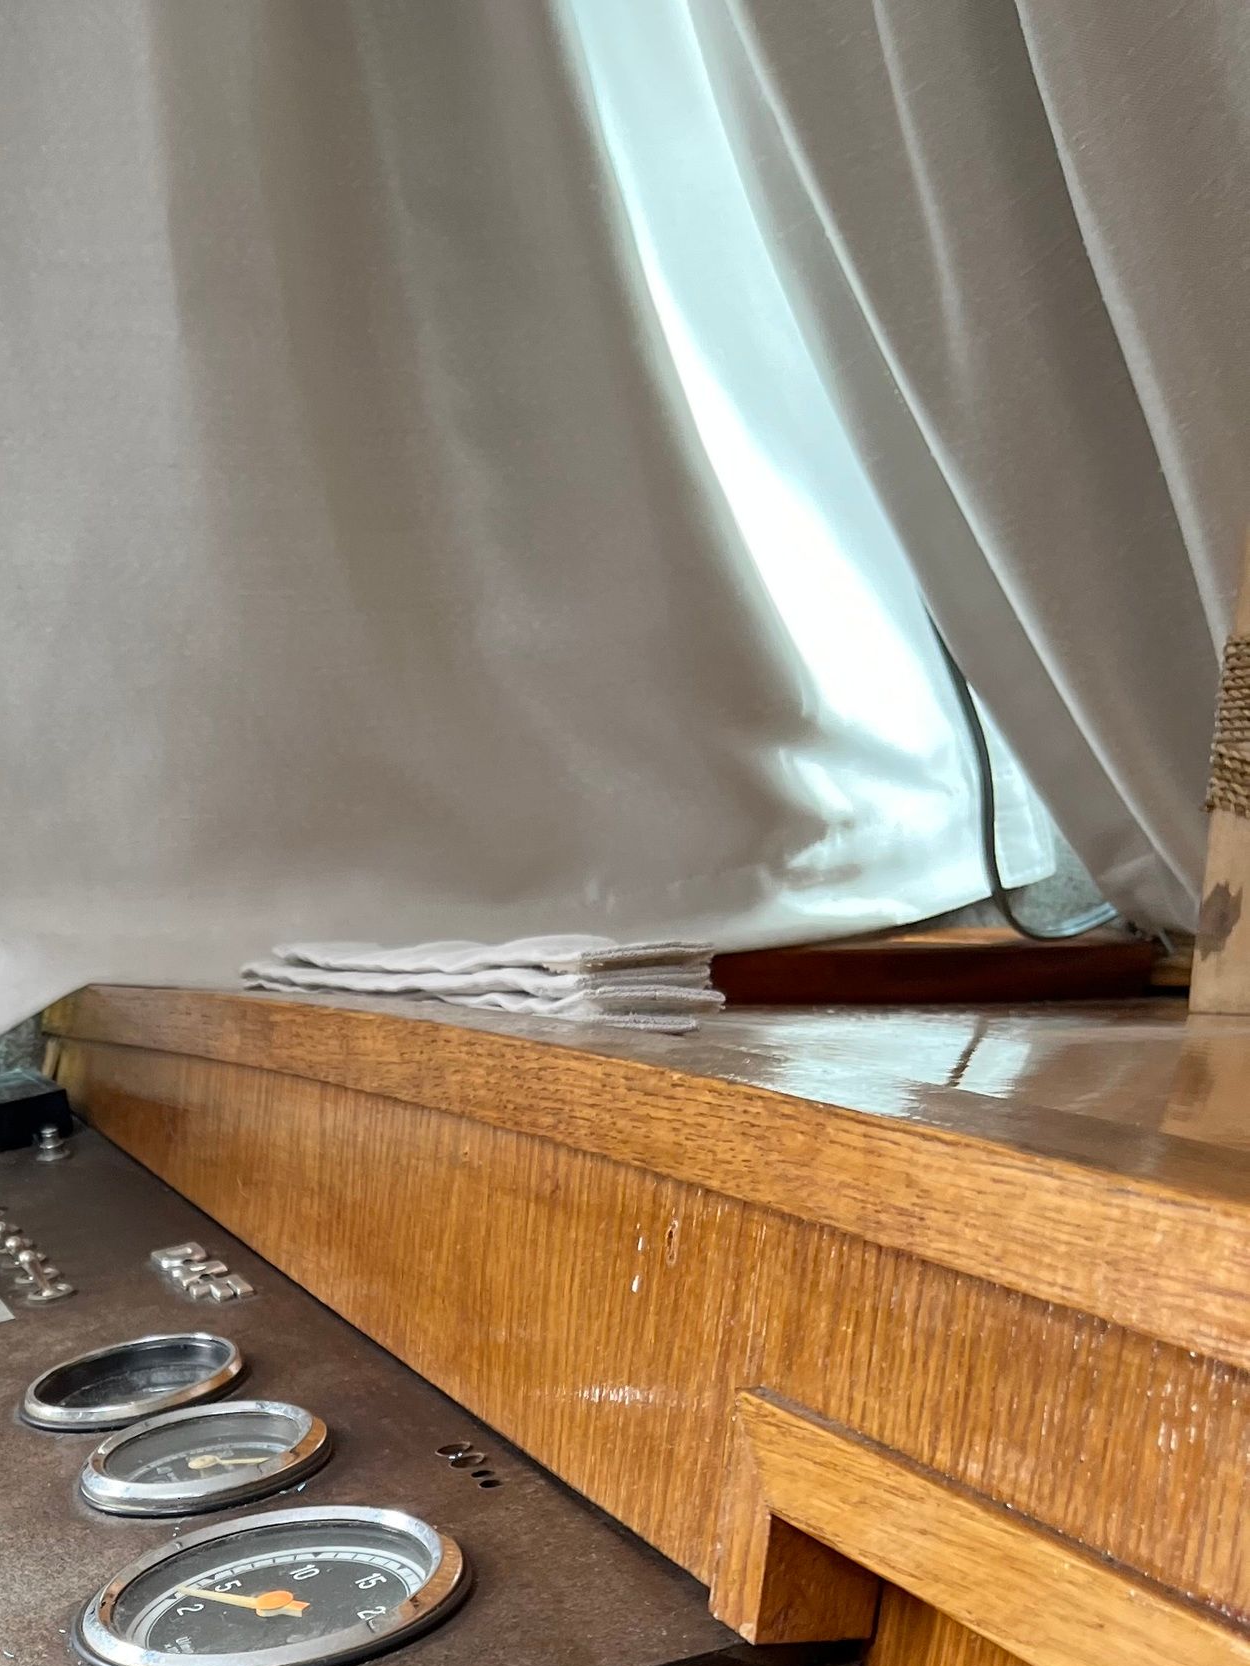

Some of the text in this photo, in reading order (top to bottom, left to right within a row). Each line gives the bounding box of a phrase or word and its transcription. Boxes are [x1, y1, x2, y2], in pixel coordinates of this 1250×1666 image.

[176, 1603, 205, 1616] 2
[214, 1579, 242, 1592] 5
[289, 1564, 321, 1581] 10
[354, 1572, 387, 1590] 15
